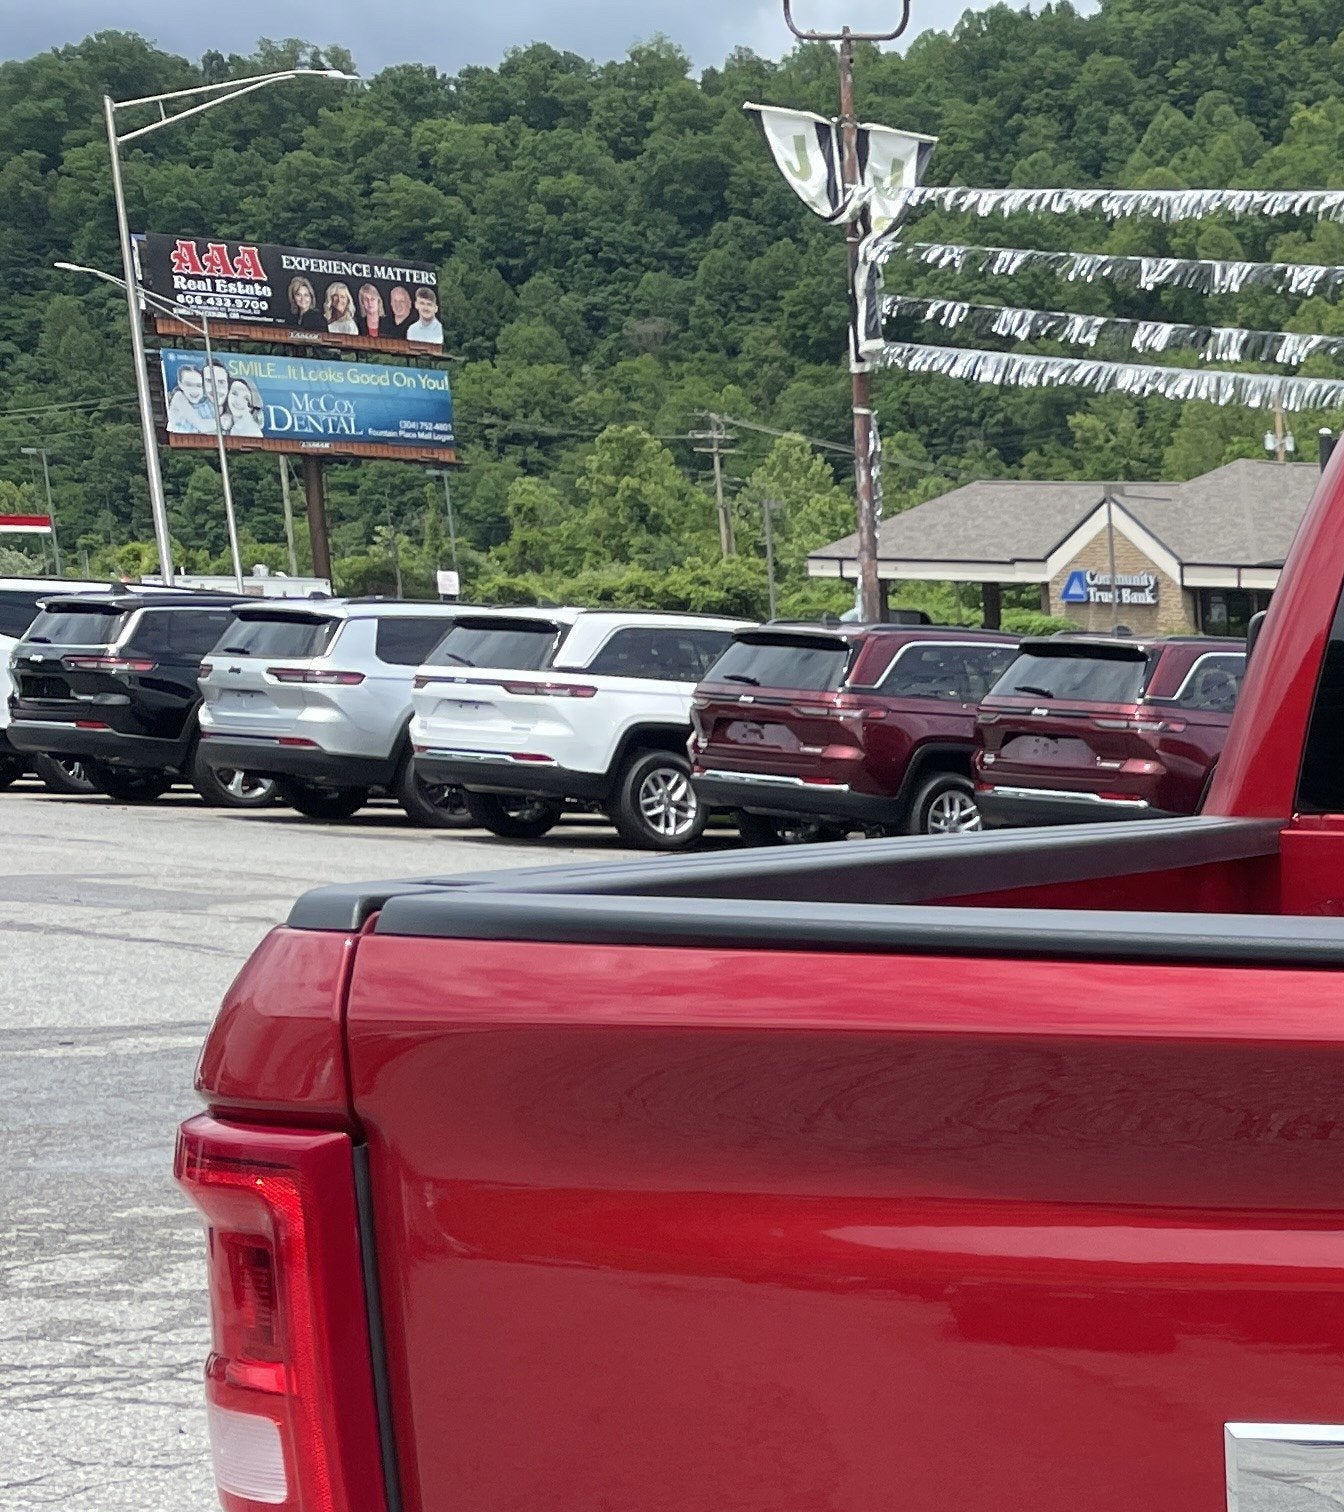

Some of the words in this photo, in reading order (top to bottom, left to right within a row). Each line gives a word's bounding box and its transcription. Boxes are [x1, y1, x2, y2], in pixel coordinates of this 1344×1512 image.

[171, 240, 267, 281] AAA
[281, 255, 372, 277] EXPERIENCE
[373, 265, 437, 285] MATTERS
[172, 275, 212, 292] Real
[214, 279, 272, 297] Estate
[300, 366, 344, 383] Looks
[346, 368, 390, 386] Good
[392, 371, 416, 388] On
[417, 374, 449, 391] You!
[266, 405, 364, 436] DENTAL
[1121, 587, 1157, 604] Bank
